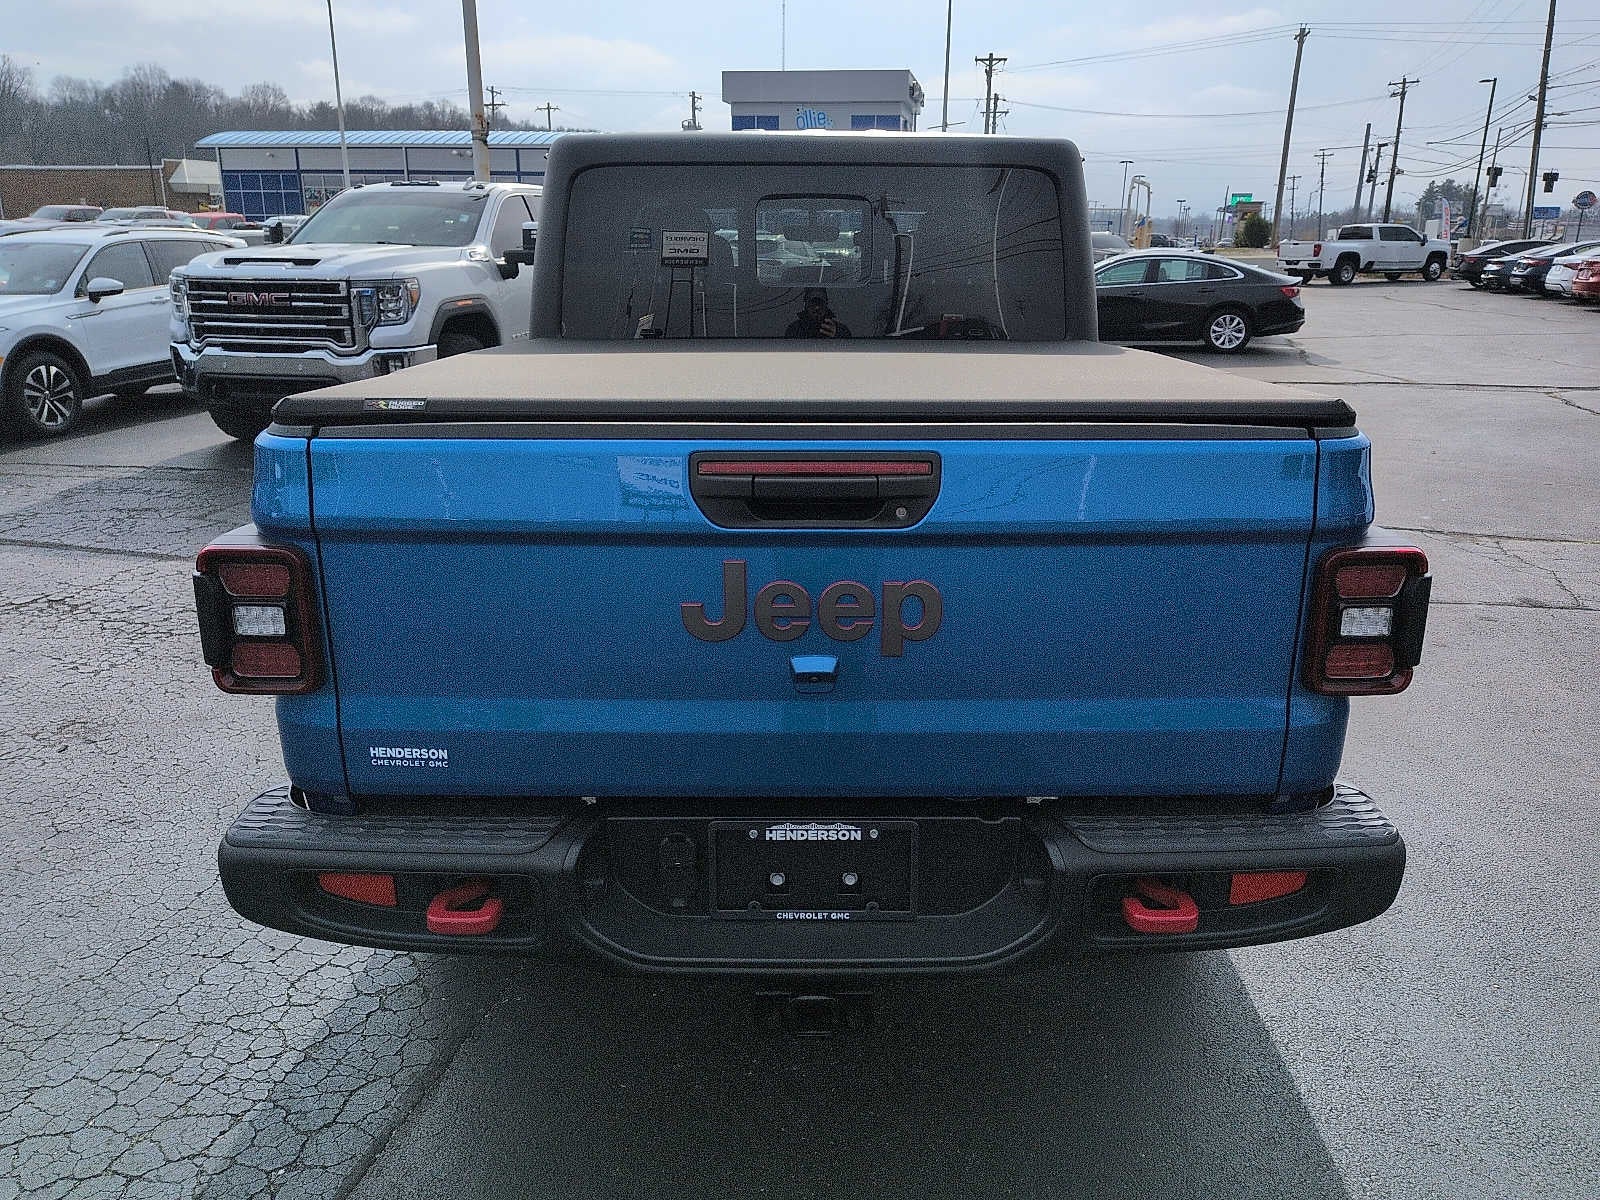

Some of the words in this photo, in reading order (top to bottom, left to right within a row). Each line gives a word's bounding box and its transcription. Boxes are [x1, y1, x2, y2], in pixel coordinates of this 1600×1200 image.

[228, 292, 290, 306] GMC
[680, 559, 943, 657] Jeep
[369, 747, 449, 760] HENDERSON
[371, 759, 426, 767] CHEVROLET
[429, 760, 449, 768] GMC
[765, 830, 862, 841] HENDERSON
[776, 912, 829, 920] CHEVROLET
[830, 912, 850, 920] GMC
